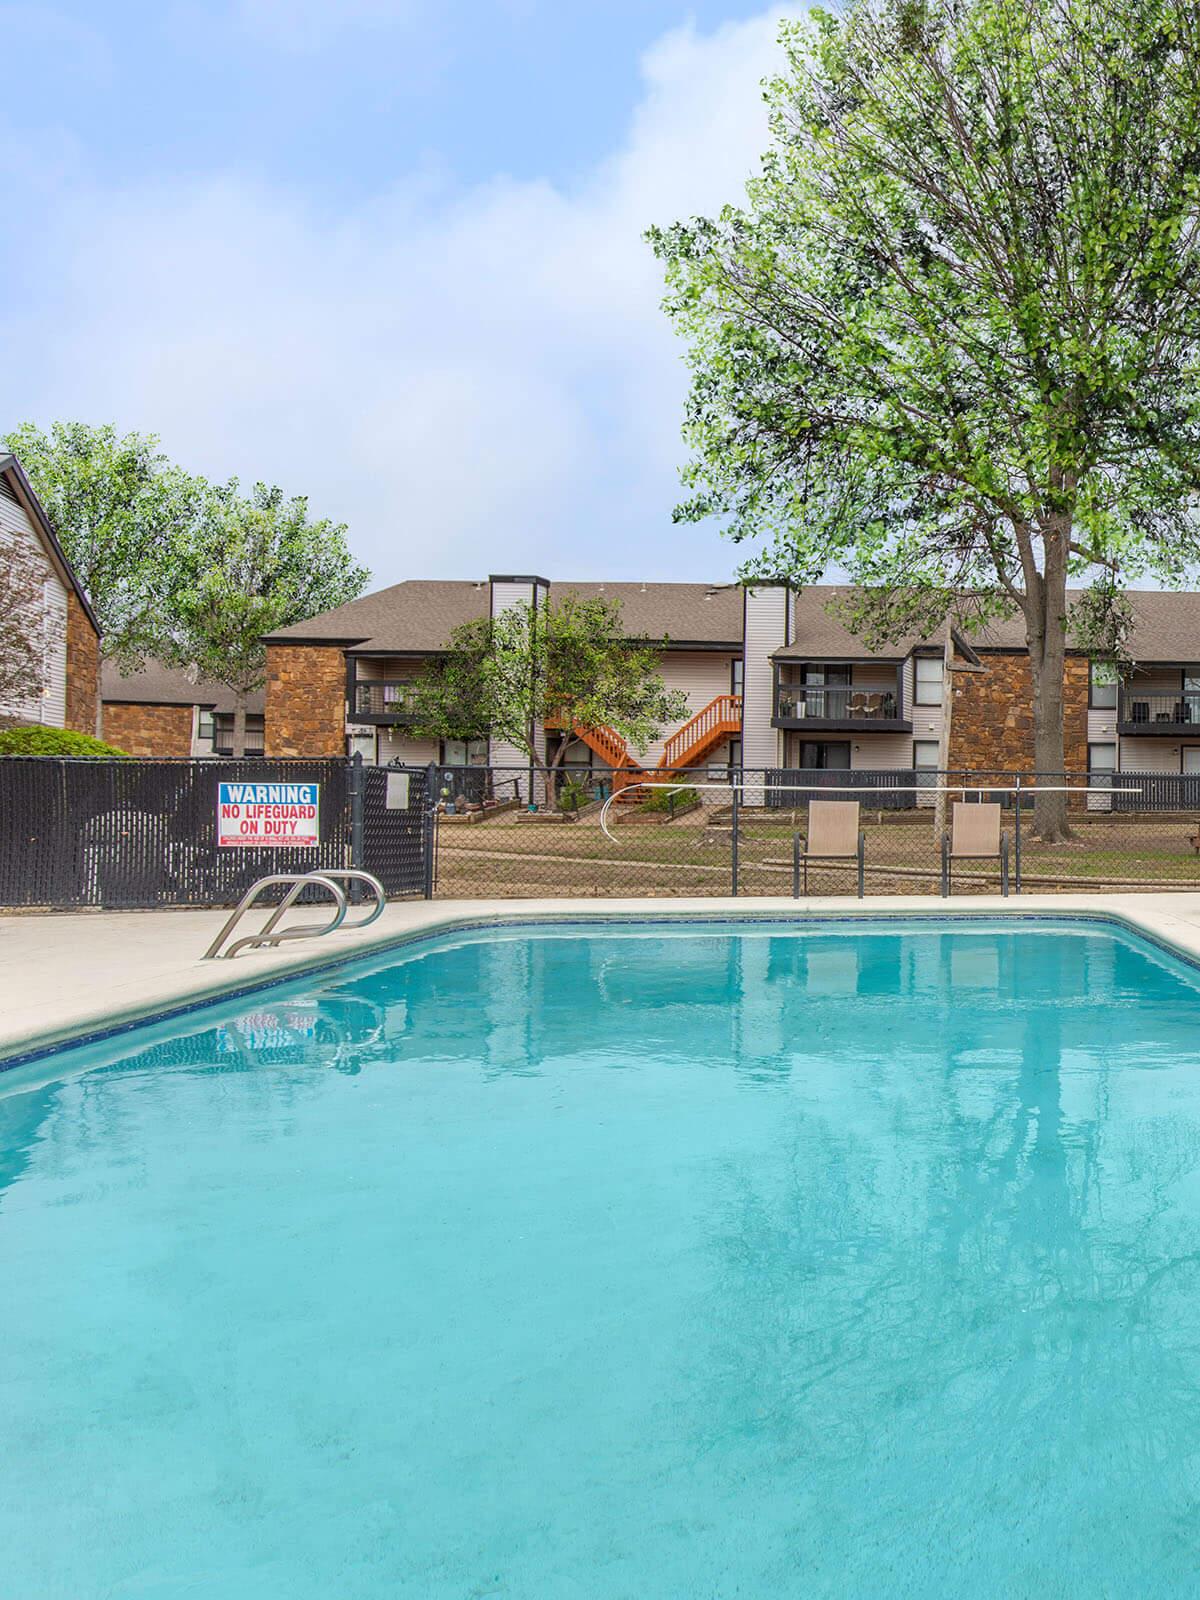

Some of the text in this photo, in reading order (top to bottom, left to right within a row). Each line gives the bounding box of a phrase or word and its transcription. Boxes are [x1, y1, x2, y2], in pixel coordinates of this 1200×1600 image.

[227, 785, 312, 803] WARNING
[222, 804, 316, 819] NO LIFEGUARD
[240, 820, 298, 834] ON DUTY
